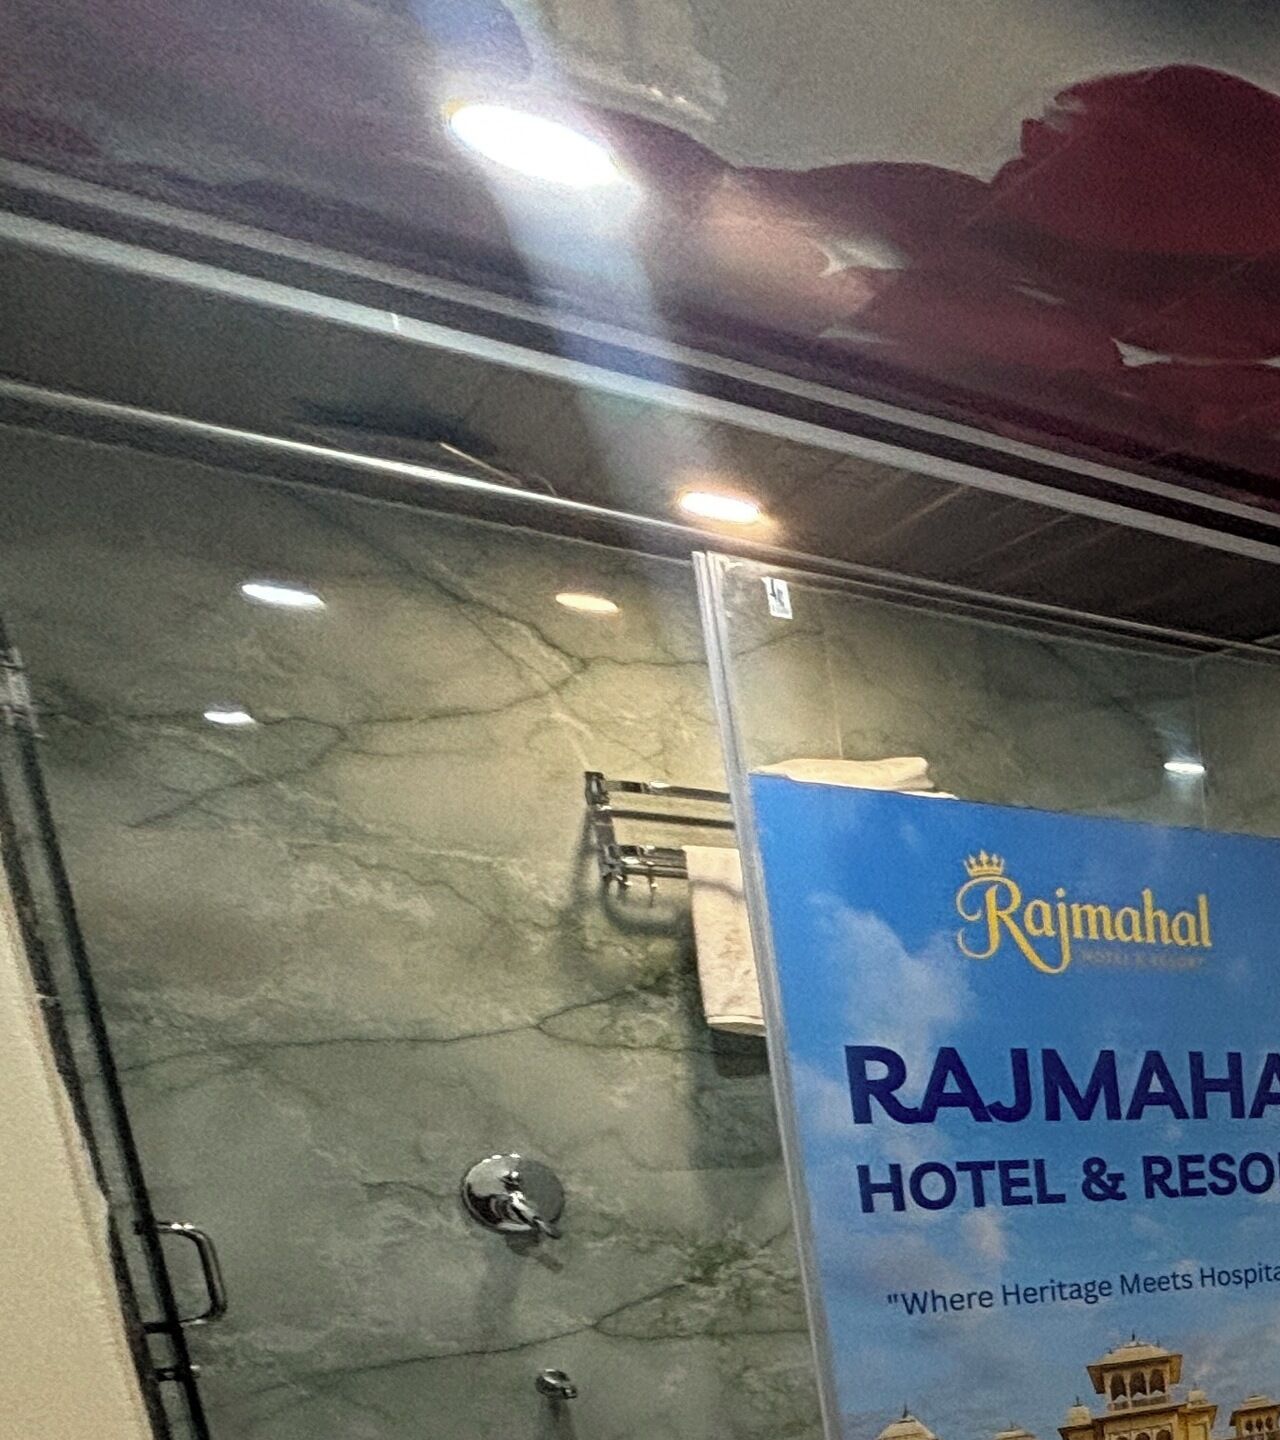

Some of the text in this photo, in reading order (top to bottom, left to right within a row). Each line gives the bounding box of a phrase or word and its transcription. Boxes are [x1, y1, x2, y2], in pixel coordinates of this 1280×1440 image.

[955, 874, 1213, 974] Rajmahal
[856, 1157, 1067, 1214] HOTEL
[1081, 1156, 1128, 1202] &
[886, 1288, 994, 1316] "Where
[1001, 1277, 1113, 1306] Heritage
[1119, 1270, 1193, 1296] Meets
